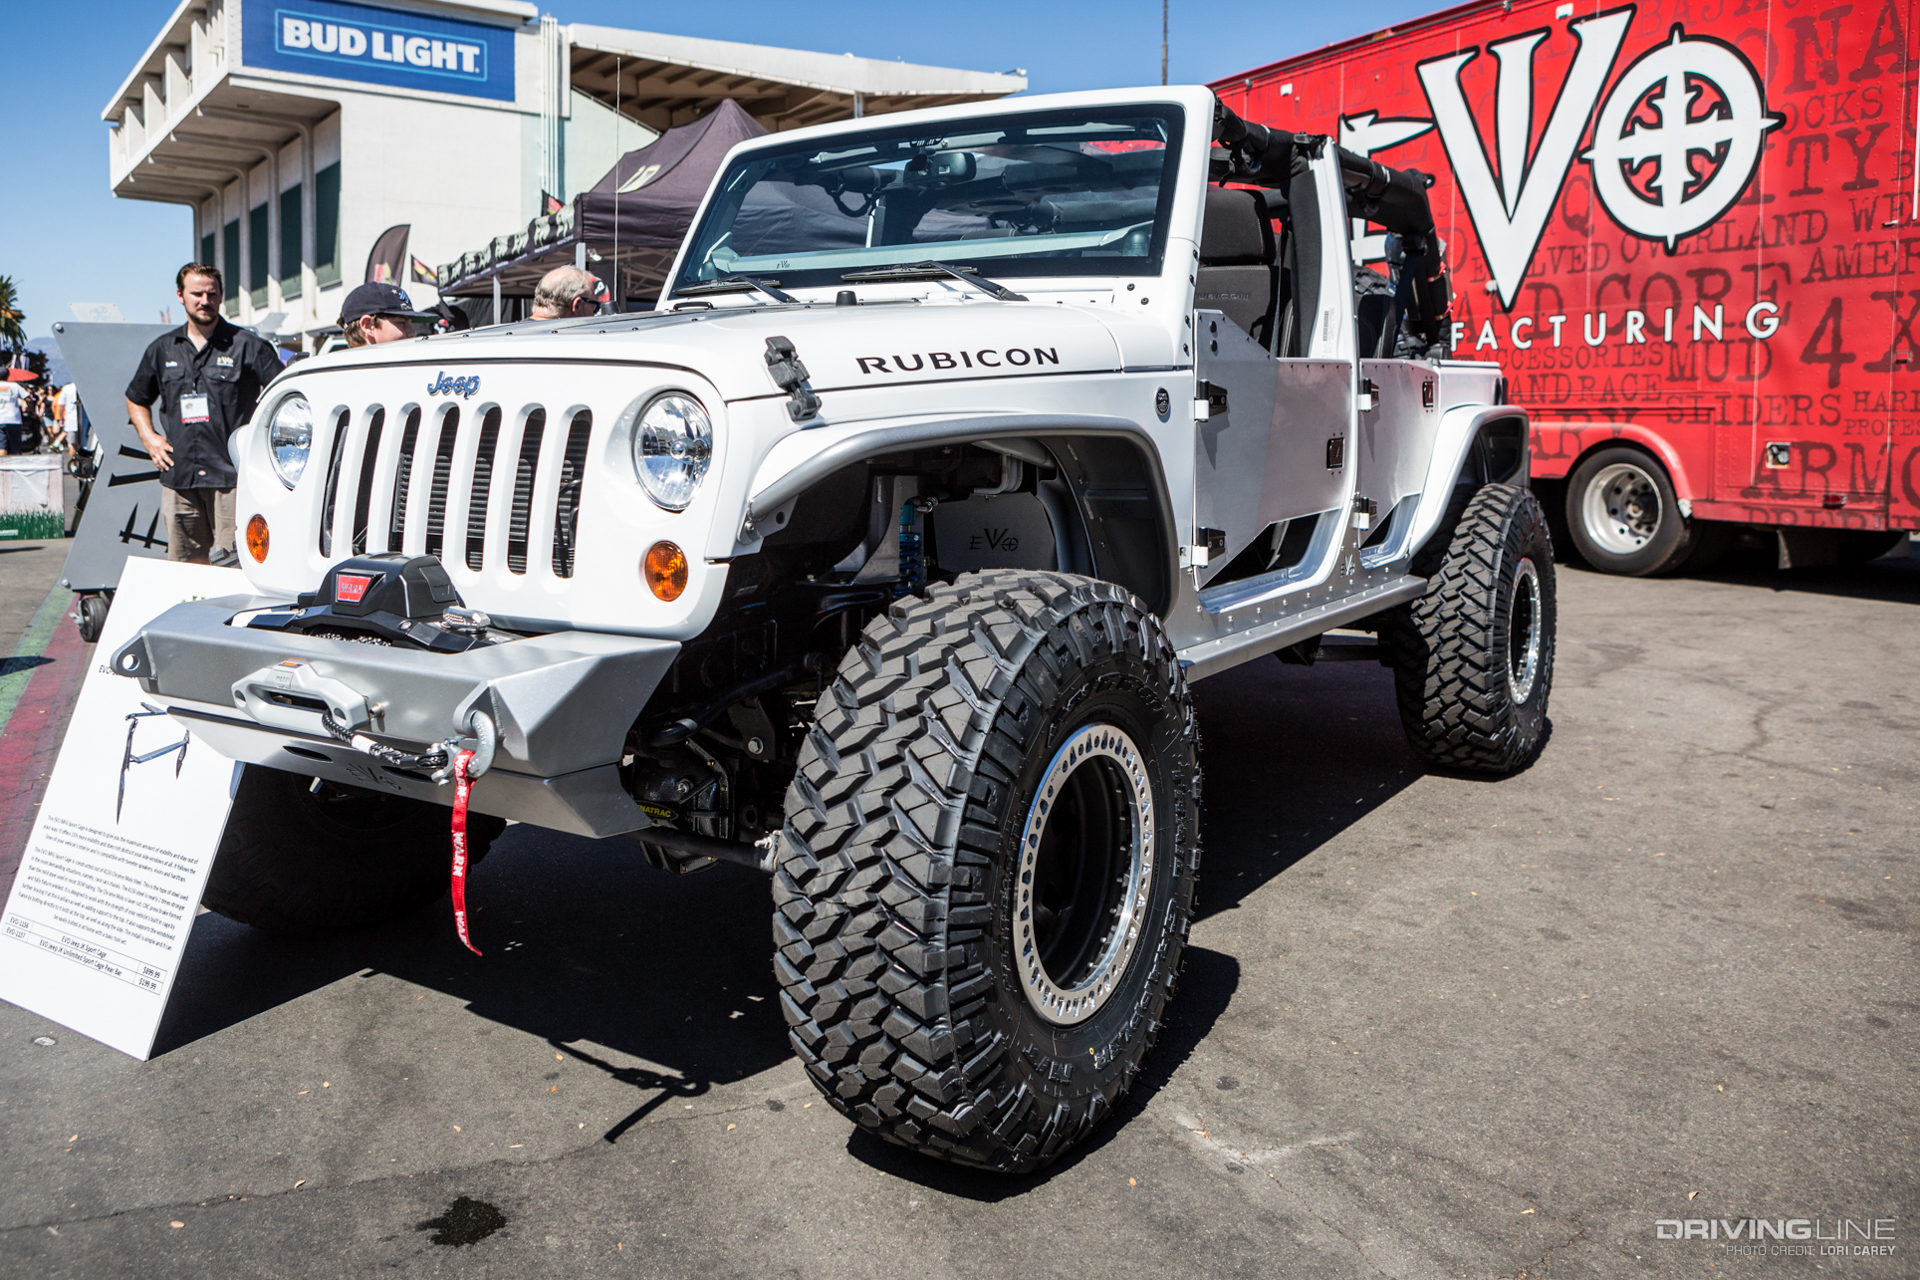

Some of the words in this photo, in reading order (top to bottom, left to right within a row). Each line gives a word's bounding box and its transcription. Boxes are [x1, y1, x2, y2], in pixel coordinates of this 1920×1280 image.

[283, 17, 367, 56] BUD
[371, 31, 480, 74] LIGHT
[855, 347, 1060, 374] RUBICON
[1665, 337, 1772, 383] MUD
[427, 371, 480, 399] Jeep
[1666, 393, 1841, 426] SLIDERS
[969, 528, 1019, 552] EVO
[340, 583, 363, 594] WARN
[454, 754, 469, 798] WARN
[451, 831, 467, 877] WARN
